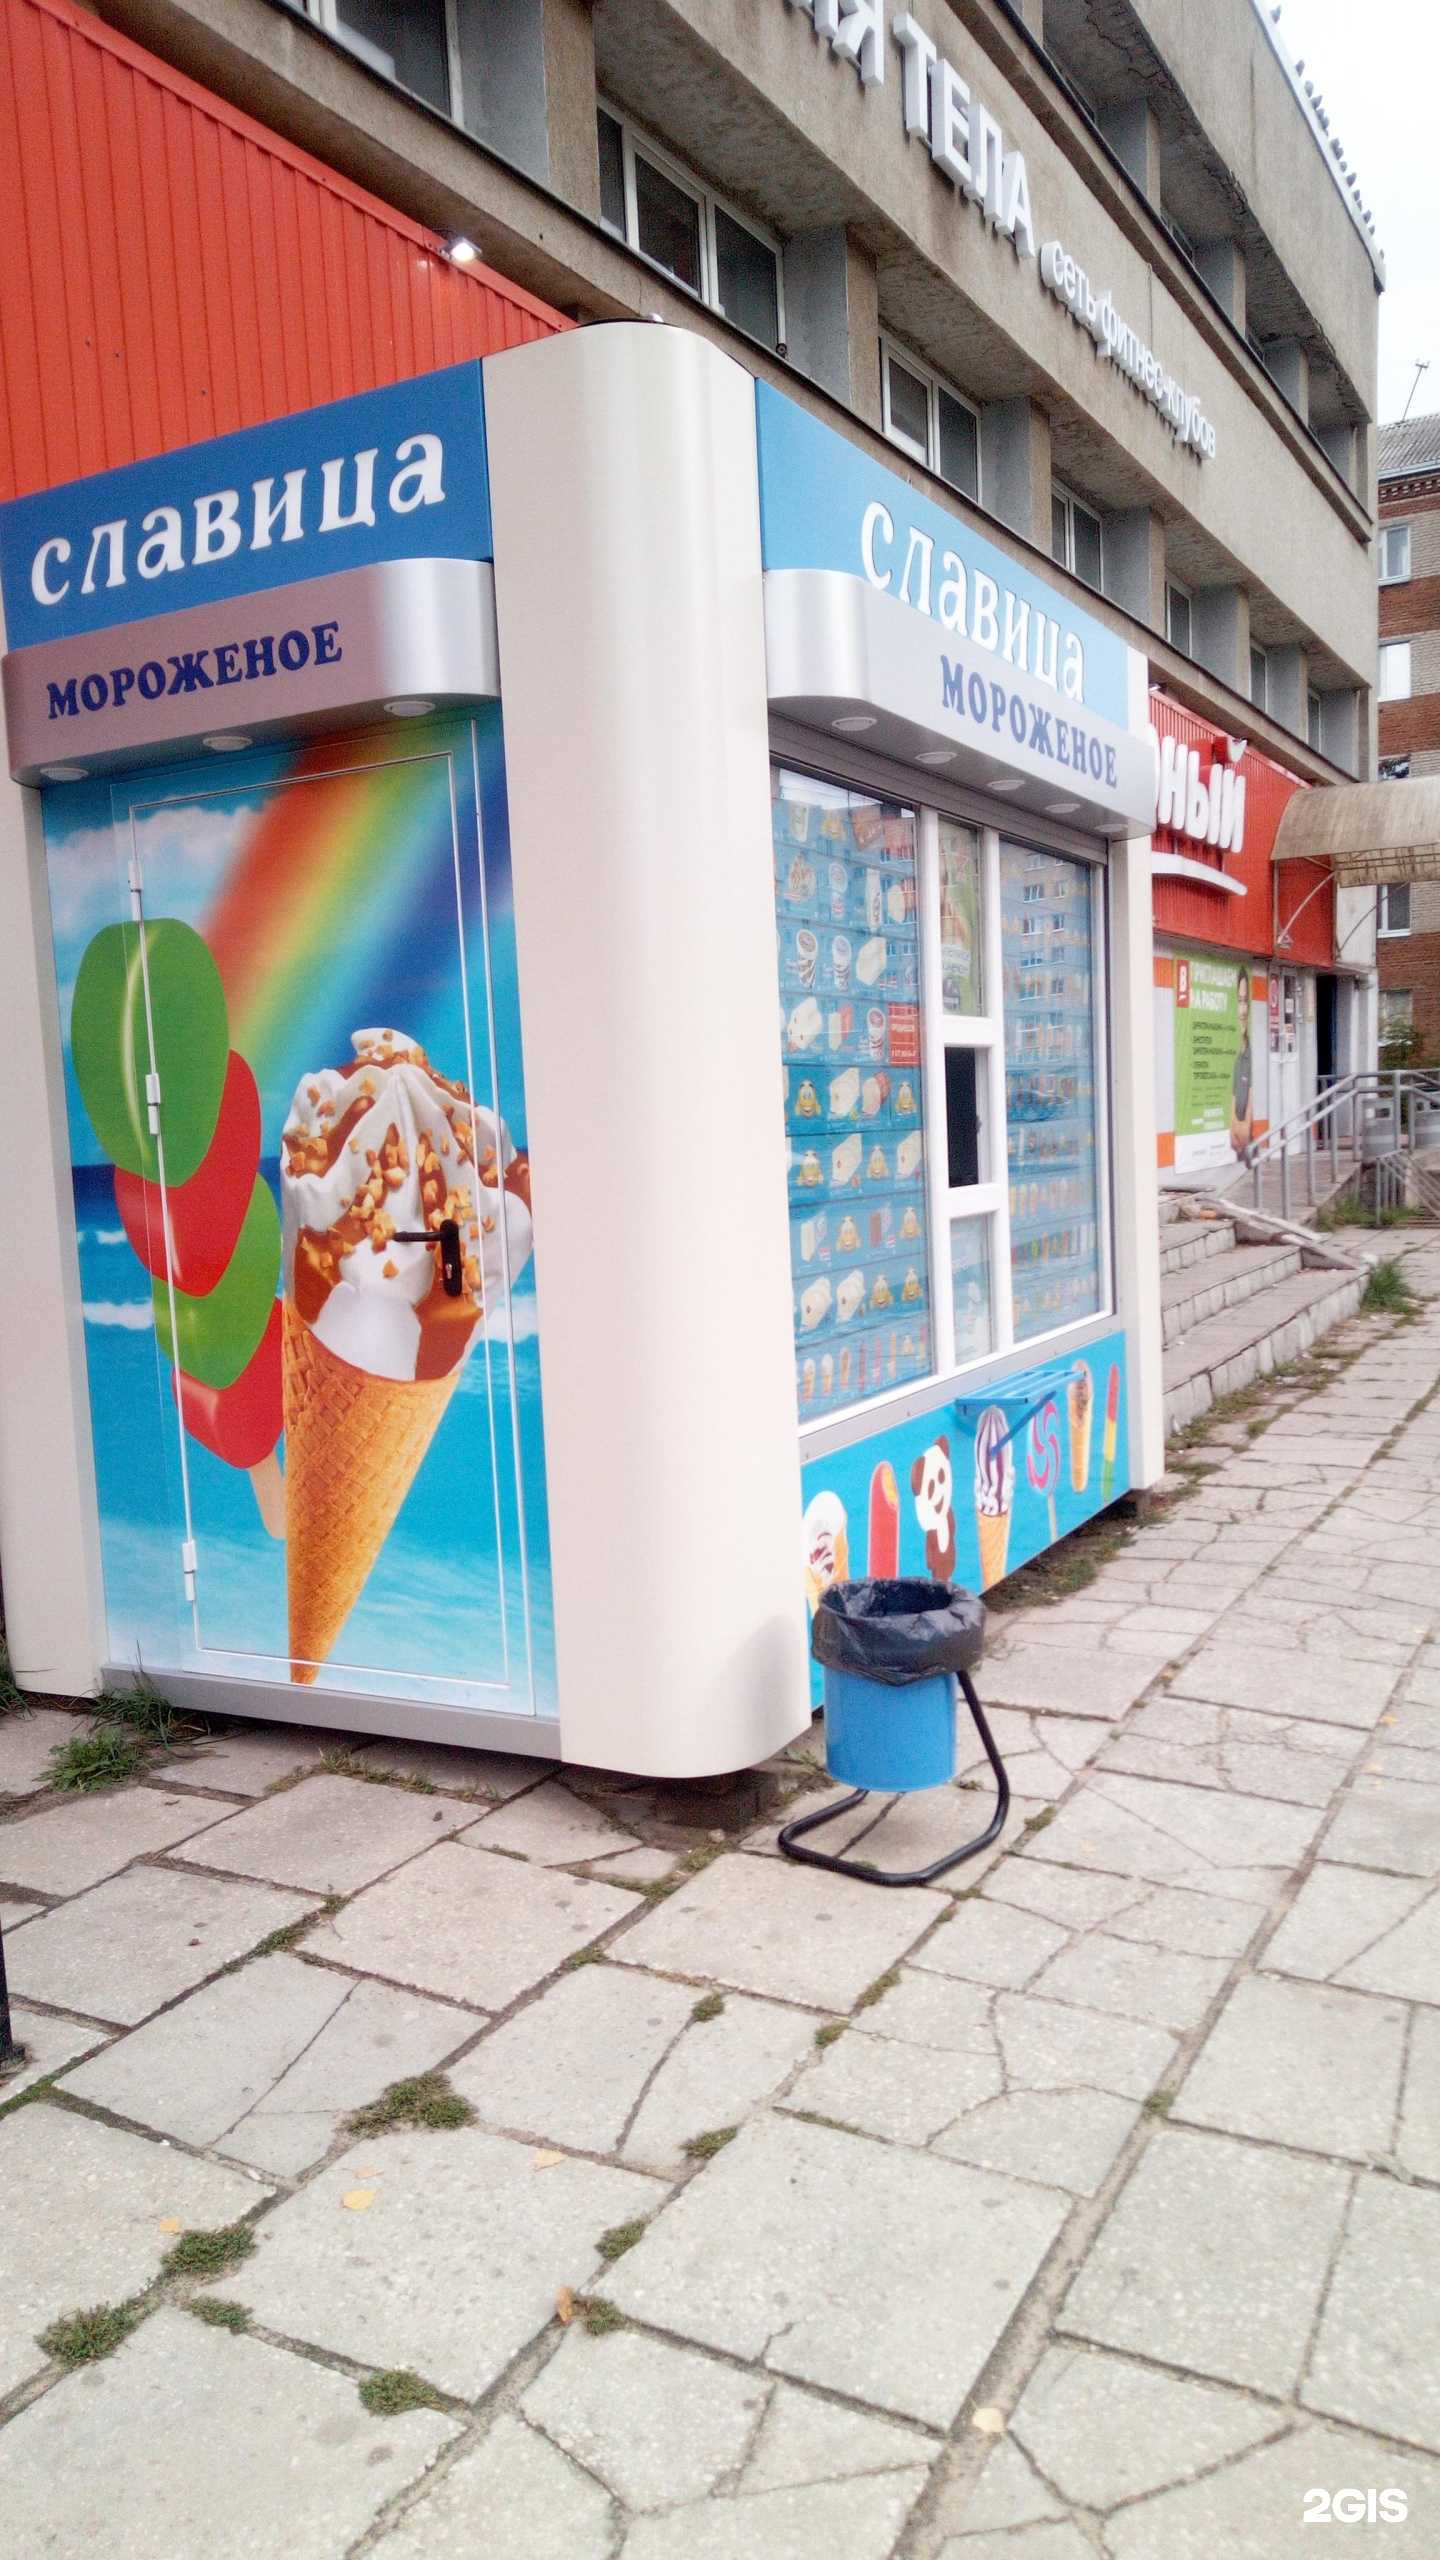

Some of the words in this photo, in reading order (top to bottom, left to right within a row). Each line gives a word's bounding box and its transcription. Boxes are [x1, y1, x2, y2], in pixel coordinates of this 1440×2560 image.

[893, 12, 1036, 258] ТЕЛА
[1093, 289, 1217, 460] фитнес-клубов
[31, 432, 446, 607] славица
[860, 501, 1085, 704] славица
[46, 621, 343, 720] МОРОЖЕНОЕ
[940, 654, 1118, 789] МОРОЖЕНОЕ
